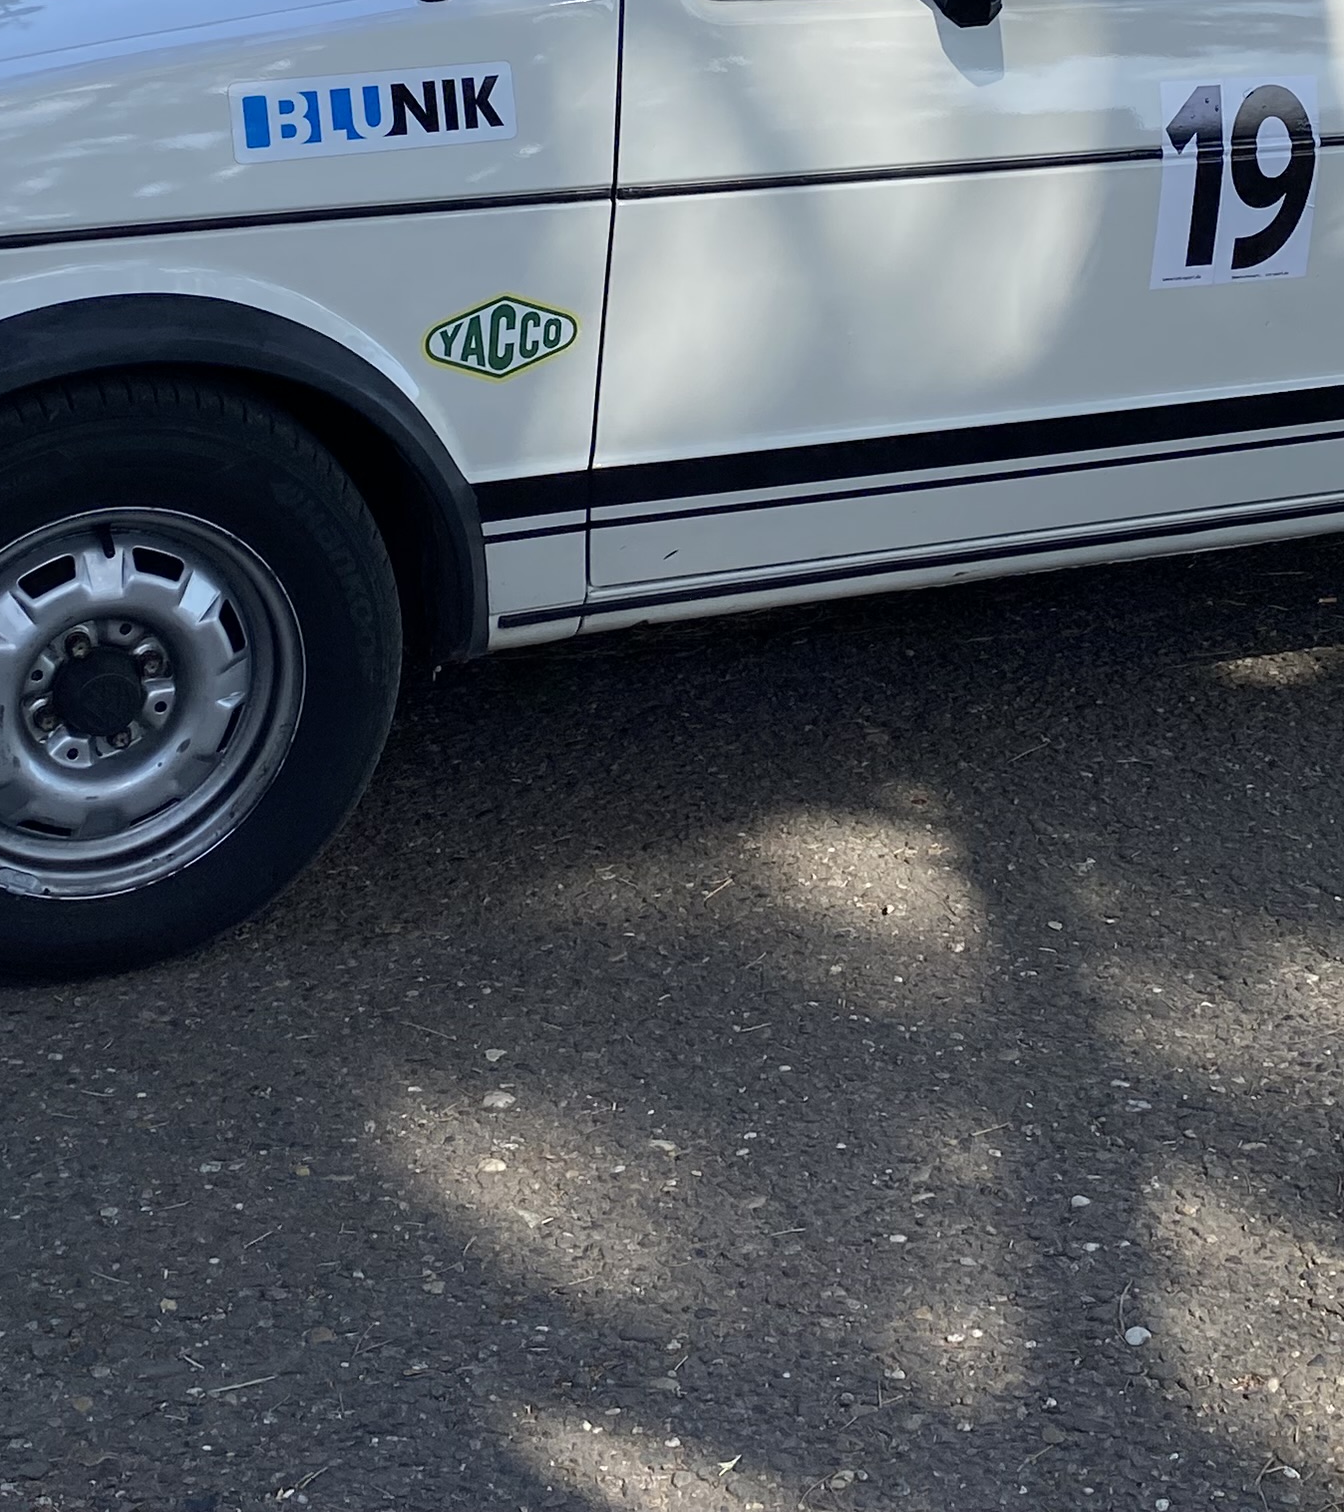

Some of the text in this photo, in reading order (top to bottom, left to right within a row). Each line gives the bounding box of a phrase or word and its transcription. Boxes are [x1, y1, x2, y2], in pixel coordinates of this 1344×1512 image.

[242, 74, 505, 150] BLUNIK
[1165, 84, 1316, 270] 19
[439, 304, 562, 371] YACCO
